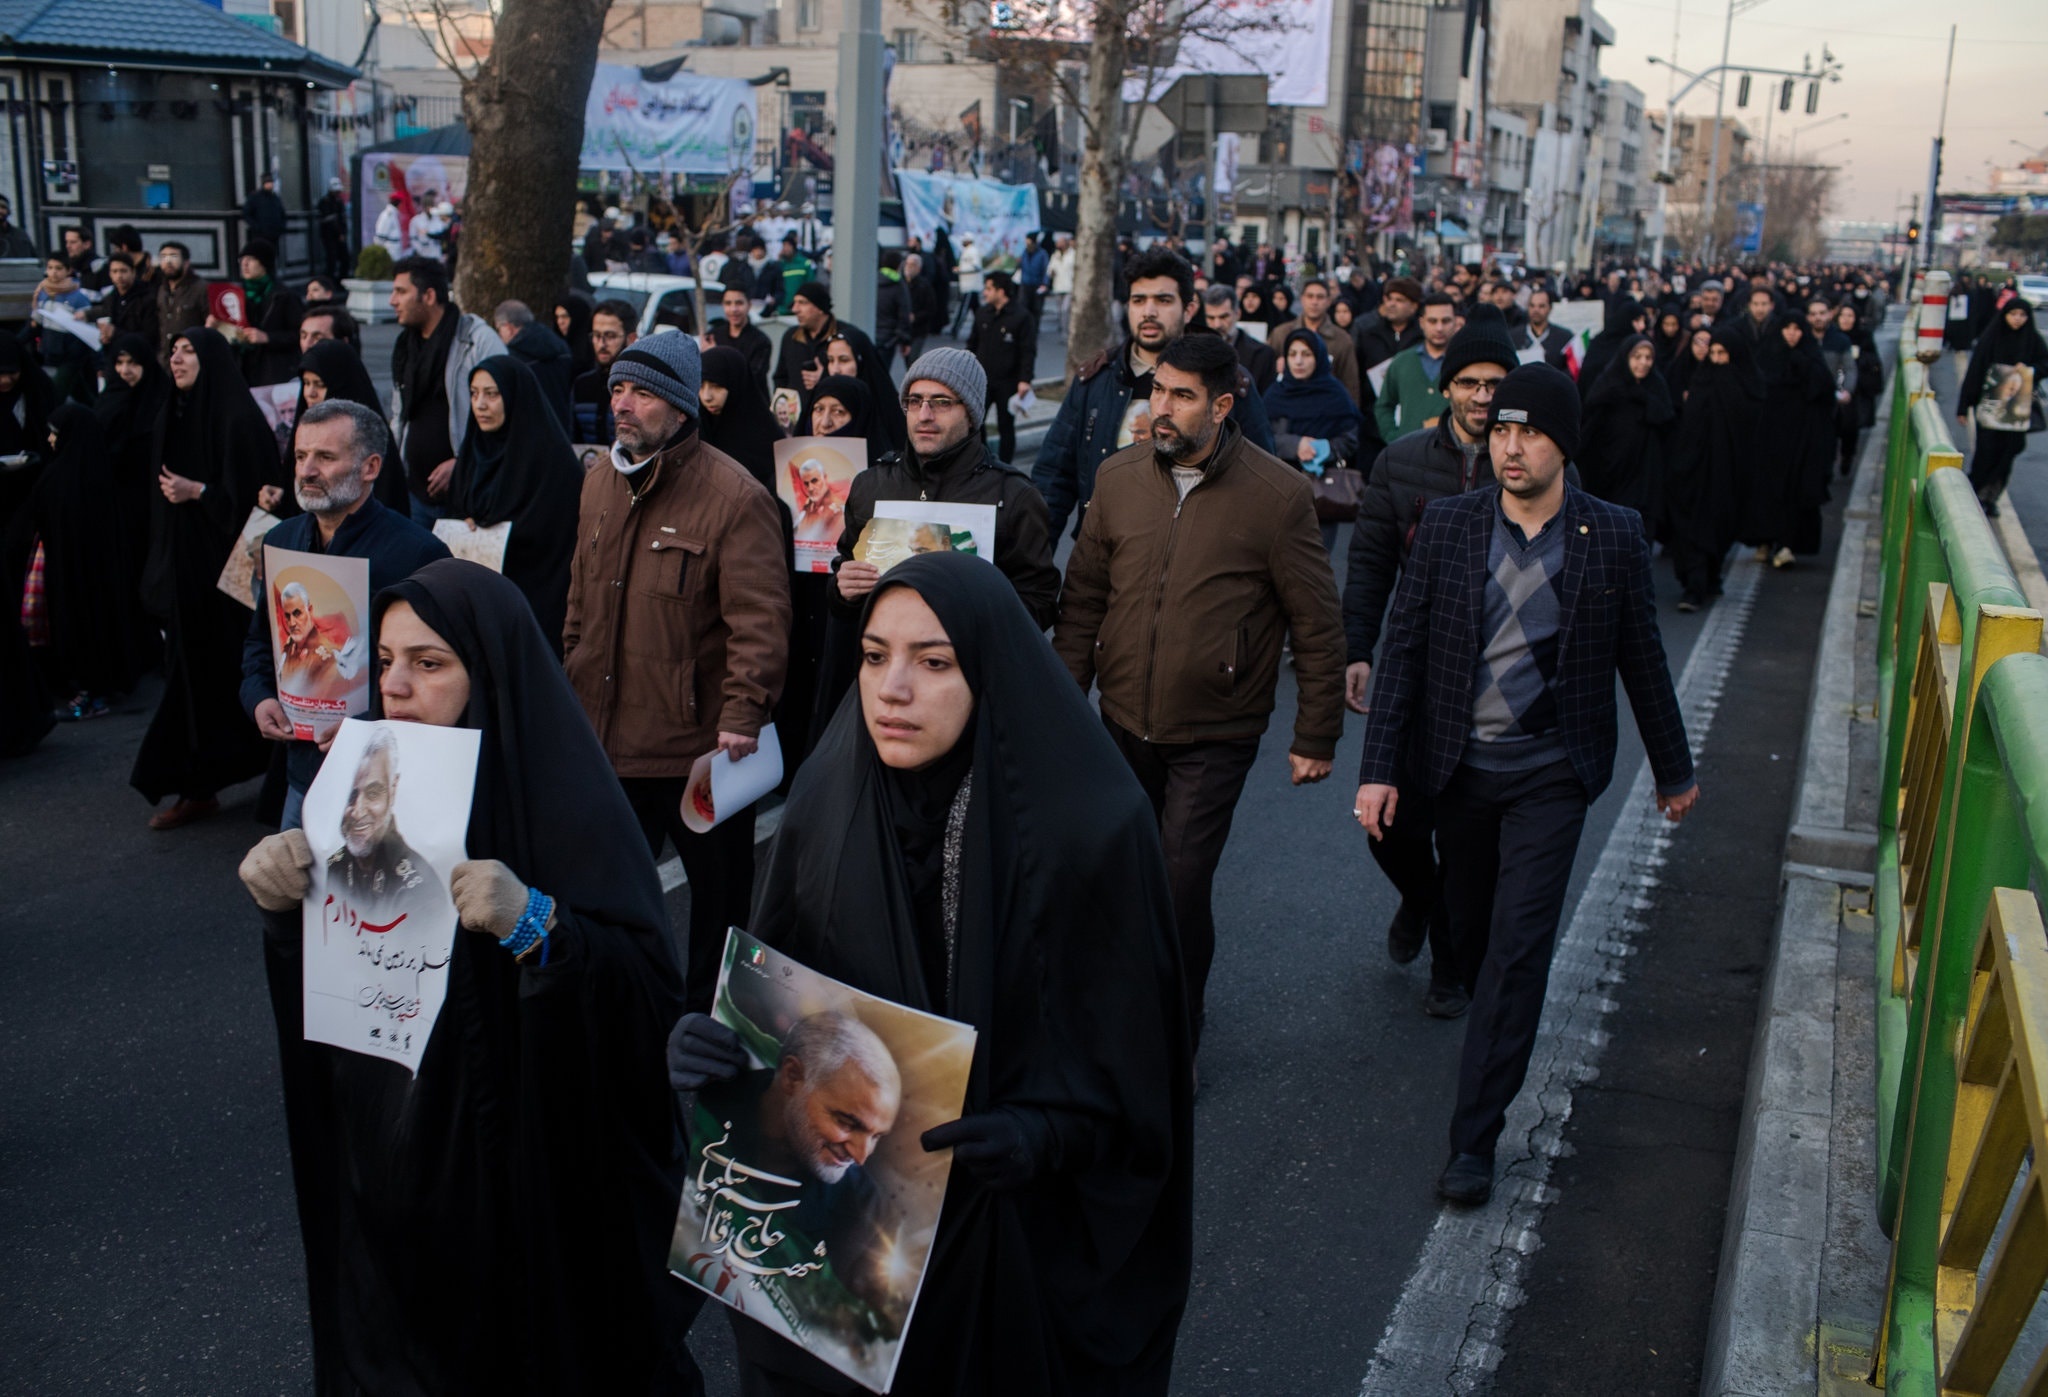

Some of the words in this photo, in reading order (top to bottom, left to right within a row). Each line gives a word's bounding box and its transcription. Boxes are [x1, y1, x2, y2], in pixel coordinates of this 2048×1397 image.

[323, 893, 408, 946] سردارم
[693, 1119, 803, 1204] سلیمانی
[700, 1186, 802, 1245] قاسم
[734, 1211, 786, 1259] حاج
[712, 1230, 827, 1292] شهید
